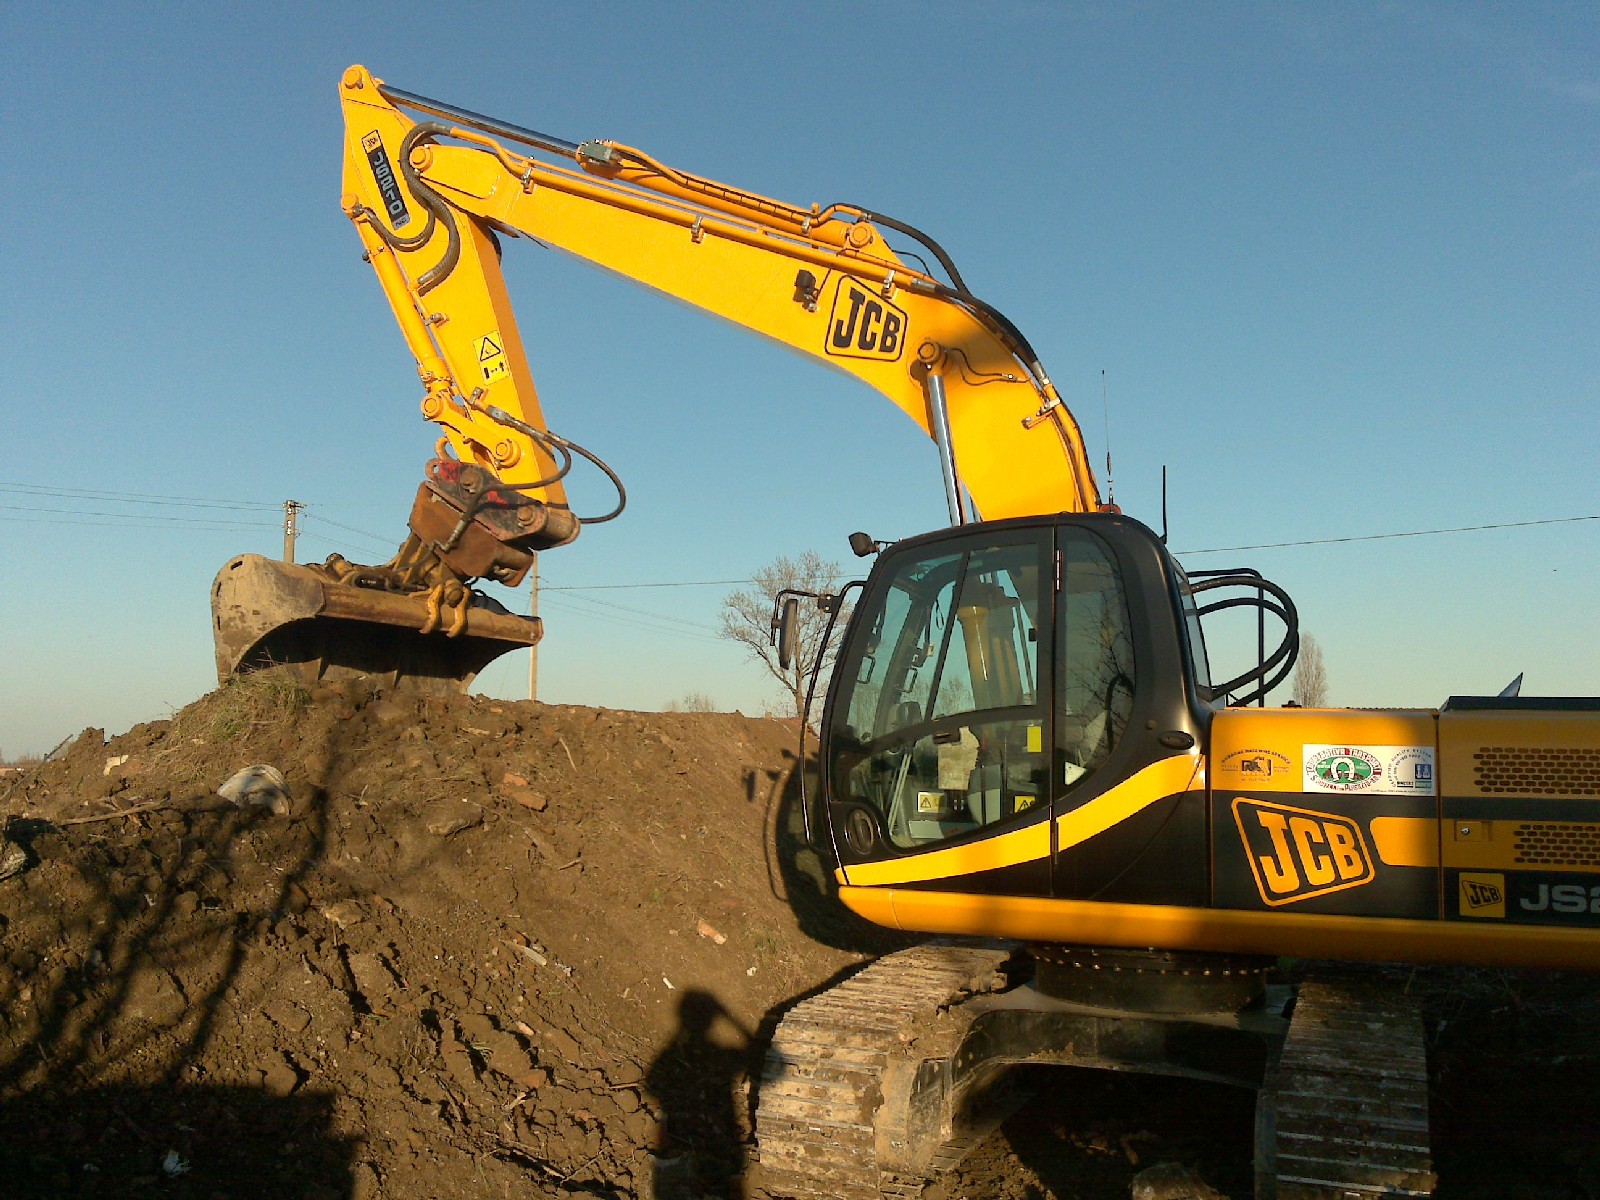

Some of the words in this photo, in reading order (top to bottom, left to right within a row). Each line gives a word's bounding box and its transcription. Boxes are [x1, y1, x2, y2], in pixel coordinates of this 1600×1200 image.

[832, 286, 901, 353] JCB
[1256, 809, 1364, 894] JCB
[1468, 882, 1501, 906] JCB
